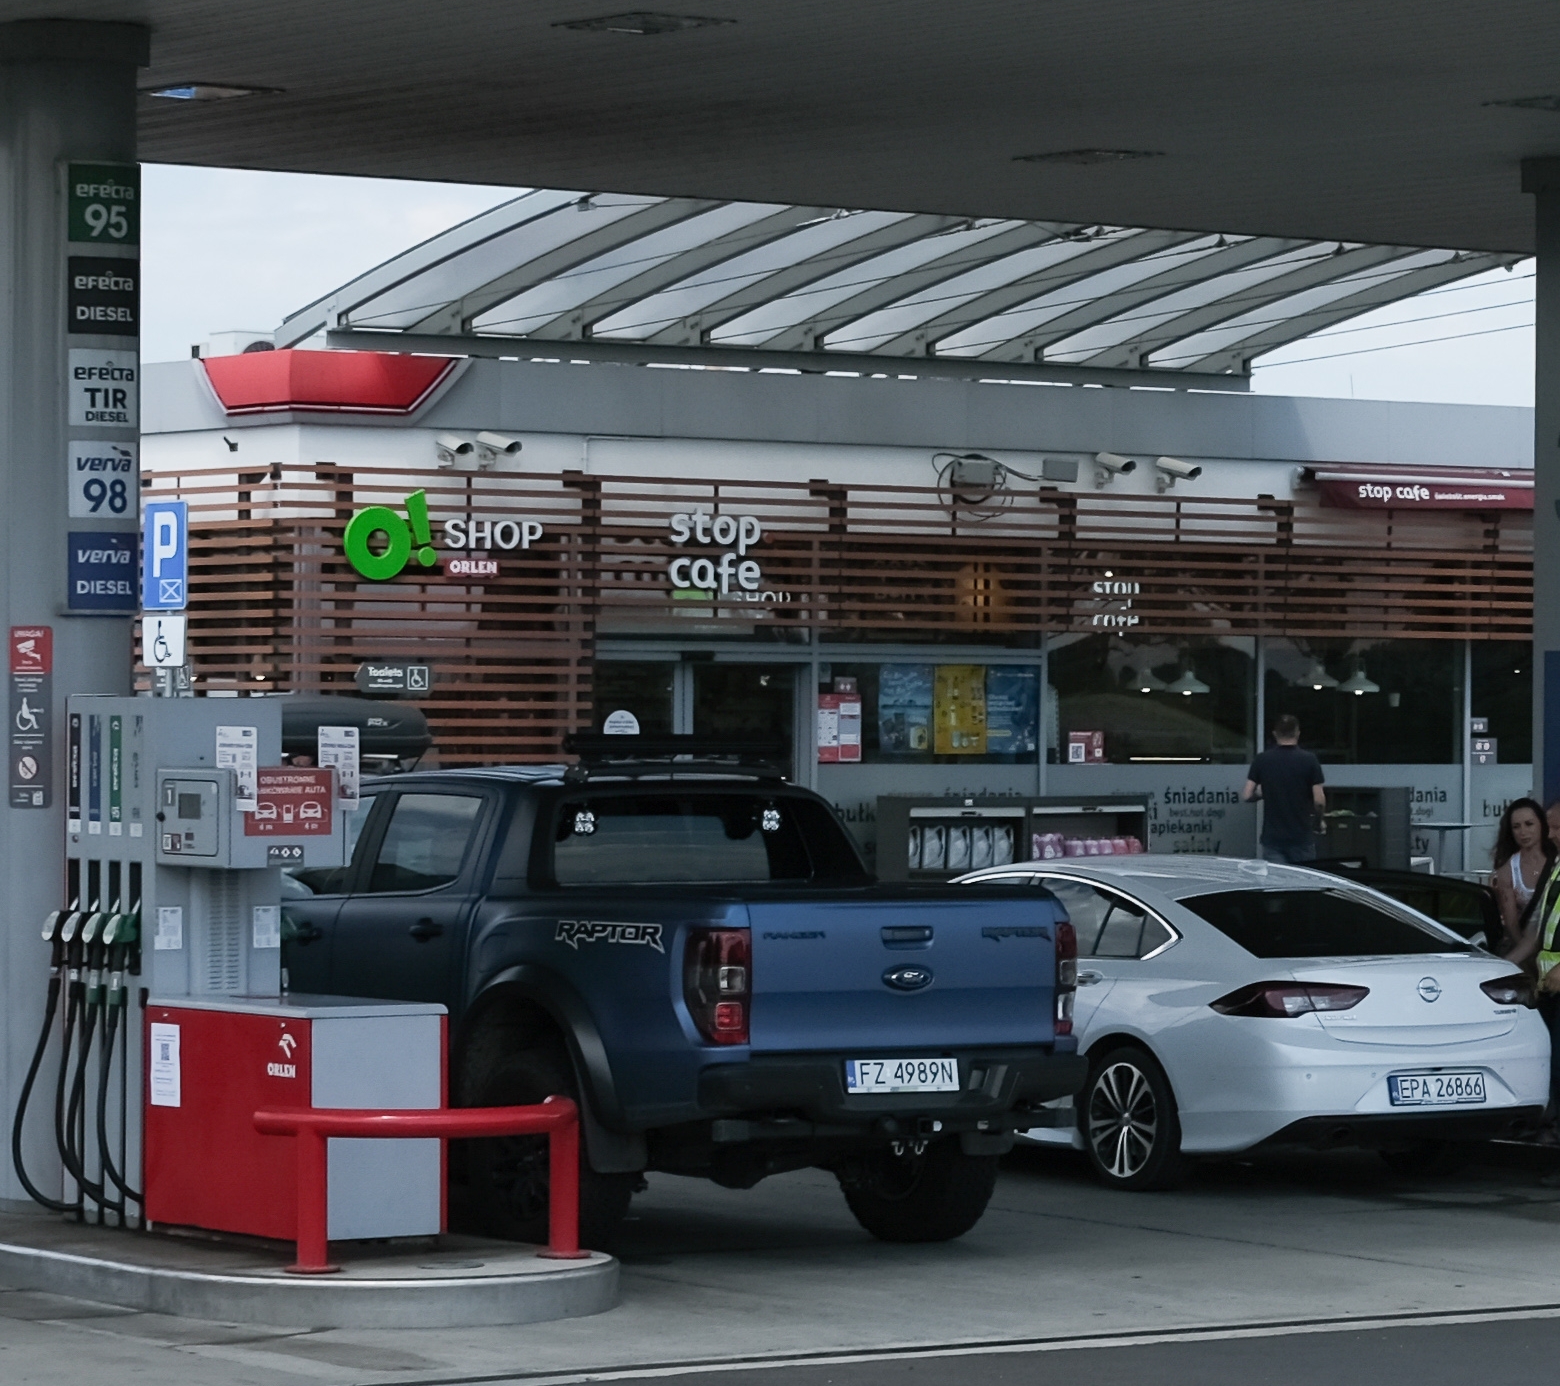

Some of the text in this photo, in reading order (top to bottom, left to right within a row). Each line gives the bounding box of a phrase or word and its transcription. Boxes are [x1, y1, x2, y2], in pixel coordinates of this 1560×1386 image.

[75, 183, 134, 200] efecta
[84, 203, 128, 239] 95
[74, 275, 134, 292] efecta
[76, 305, 134, 322] DIESEL
[74, 366, 135, 382] efecta
[84, 388, 128, 410] TIR
[85, 411, 129, 423] DIESEL
[76, 456, 132, 473] verva
[83, 477, 127, 514] 98
[1358, 484, 1391, 503] stop
[1396, 485, 1431, 501] cafe
[444, 519, 544, 551] SHOP
[668, 508, 762, 555] stop
[152, 510, 178, 578] P
[77, 549, 131, 564] verva
[449, 560, 498, 576] ORLEN
[668, 552, 762, 594] cafe
[76, 580, 133, 595] DIESEL
[1164, 785, 1240, 804] śniadania
[1409, 786, 1447, 803] dania
[1150, 819, 1213, 836] apiekanki
[554, 920, 666, 954] RAPTOR
[266, 1062, 296, 1079] ORLEN
[859, 1059, 954, 1086] FZ 4989N
[1398, 1076, 1483, 1100] EPA 26866
